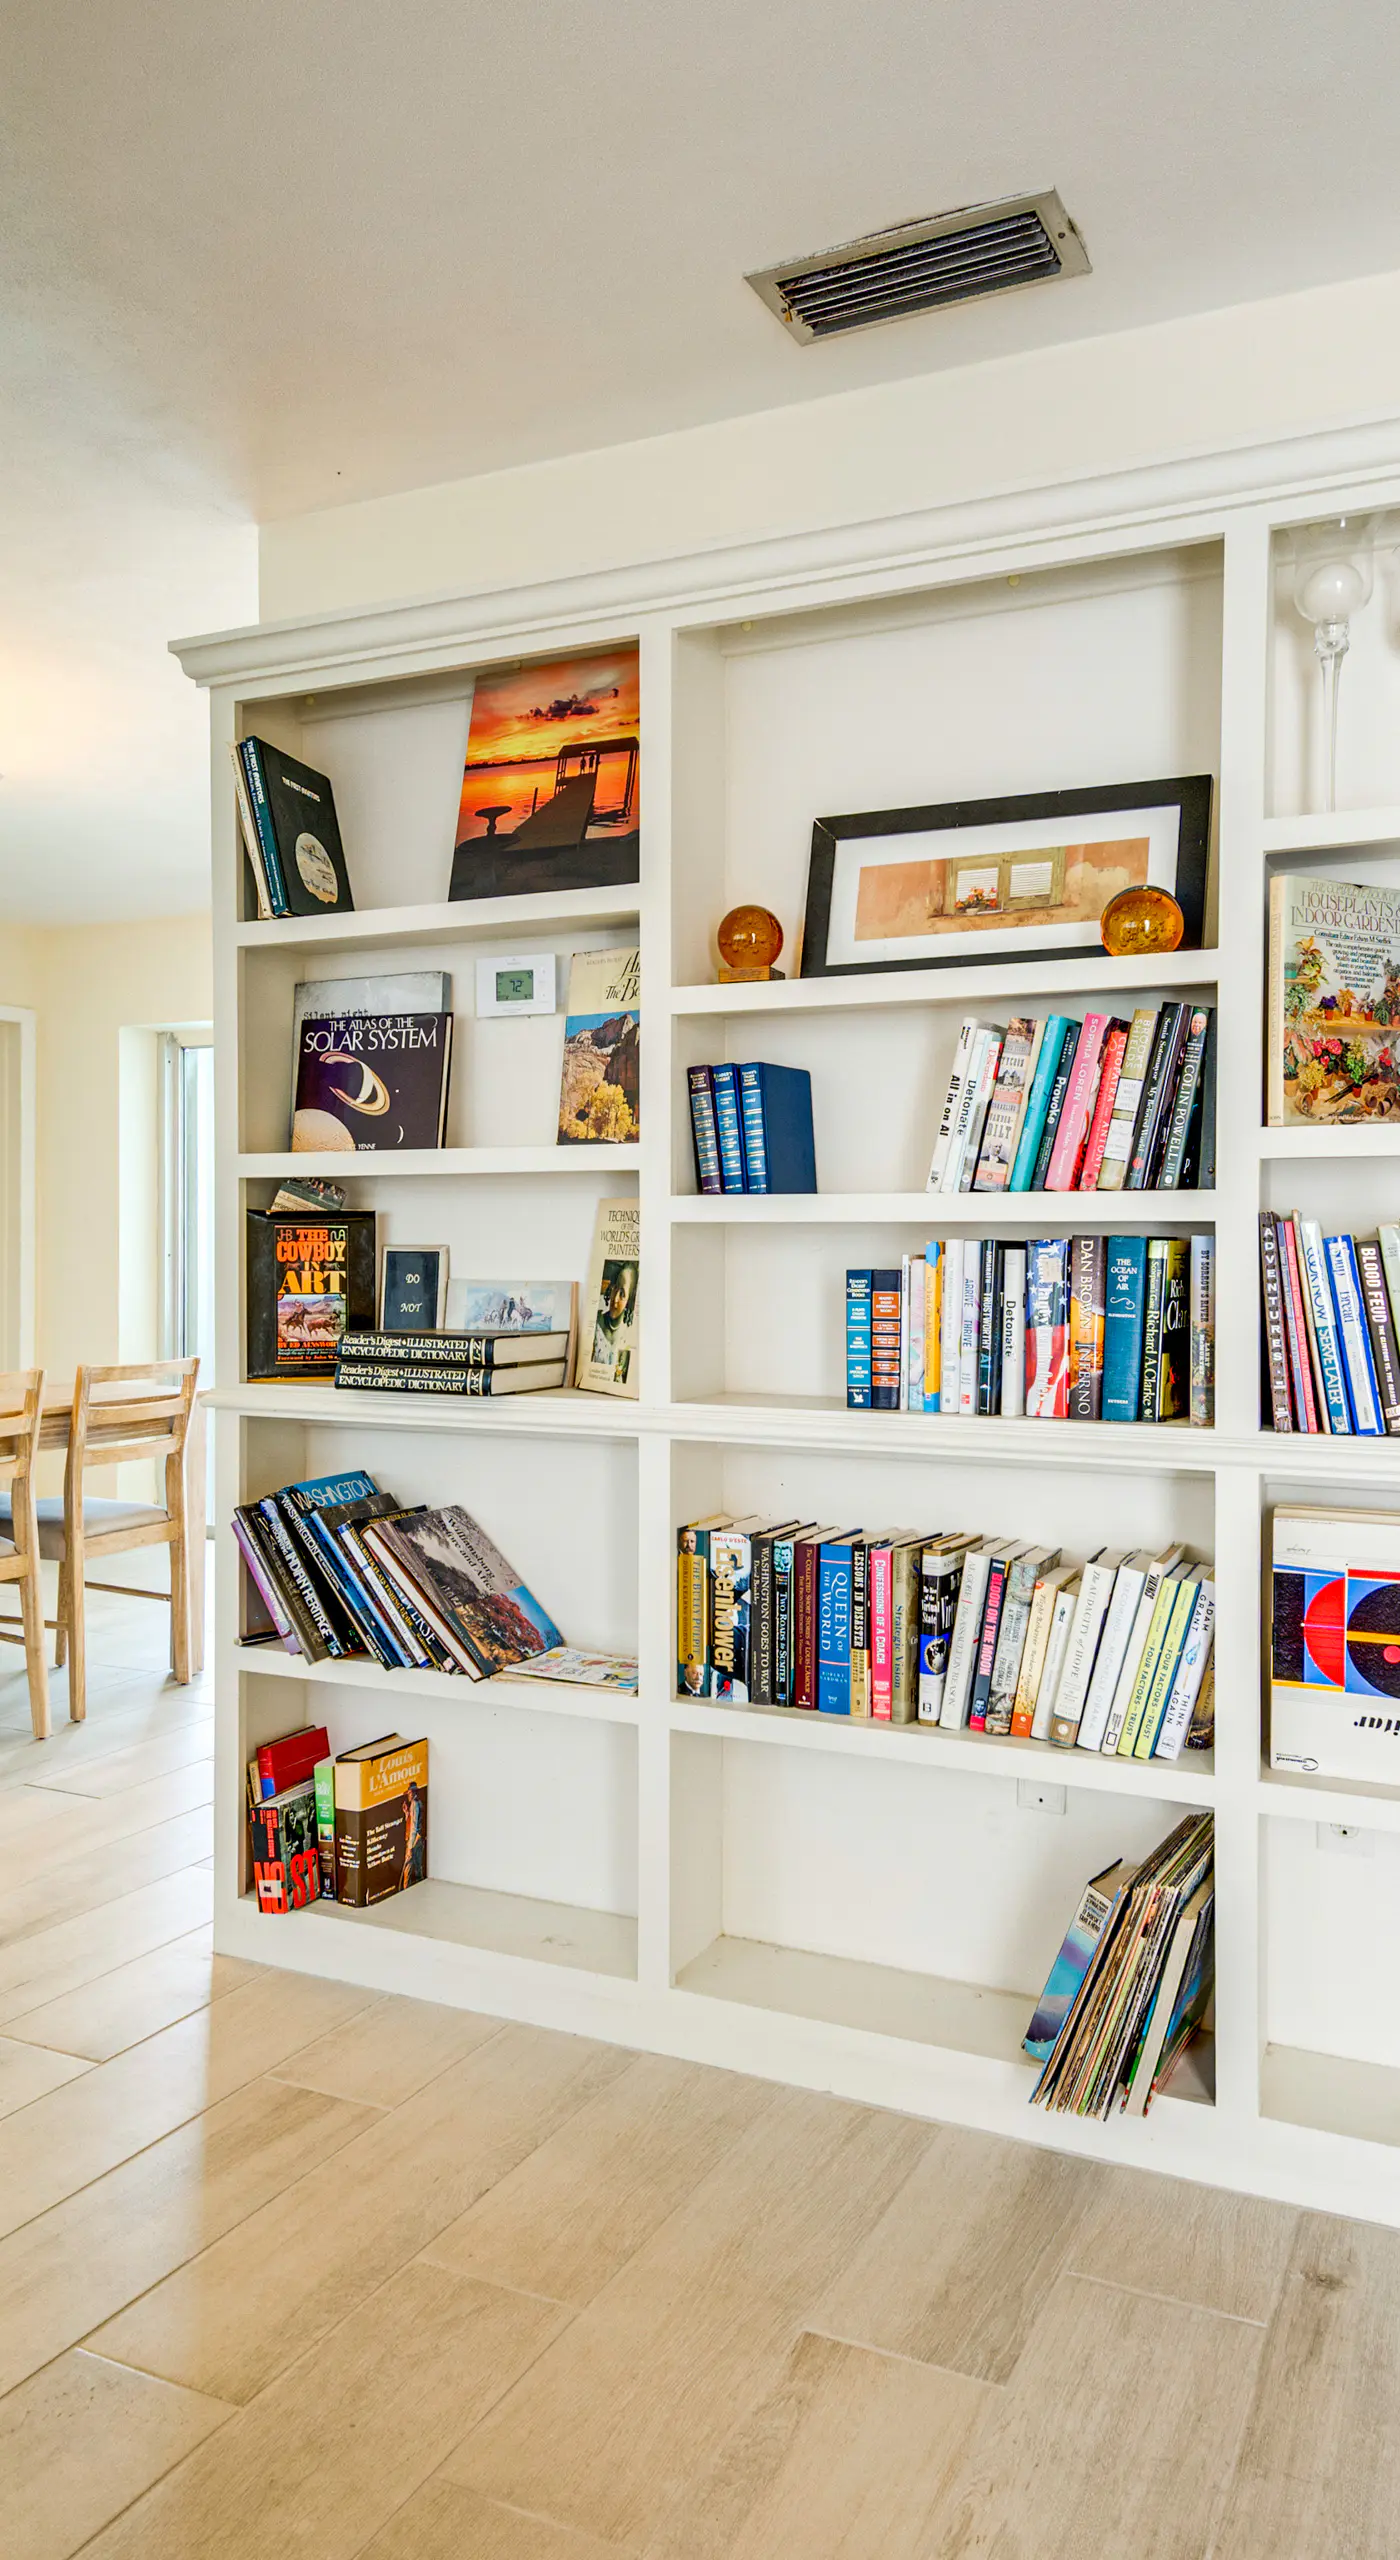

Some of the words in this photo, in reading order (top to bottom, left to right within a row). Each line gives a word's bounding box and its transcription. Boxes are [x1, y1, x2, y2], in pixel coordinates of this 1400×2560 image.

[1302, 891, 1393, 918] HOUSEPLANTS
[1292, 906, 1342, 927] INDOOR
[1344, 913, 1400, 934] GARDENI
[510, 980, 522, 992] 72
[606, 986, 618, 1000] The
[329, 1020, 346, 1031] THE
[349, 1018, 376, 1030] ATLAS
[379, 1018, 392, 1029] OF
[397, 1017, 414, 1028] THE
[1082, 1016, 1098, 1059] SOPHIA
[1160, 1016, 1171, 1039] Sonia
[304, 1031, 363, 1052] SOLAR
[368, 1028, 436, 1050] SYSTEM
[1126, 1019, 1143, 1069] SHIELDS
[1134, 1019, 1153, 1069] BROOKE
[1106, 1035, 1126, 1103] CLEOPATRA
[1150, 1040, 1166, 1080] Sotomayor
[949, 1074, 961, 1090] All
[1073, 1062, 1088, 1100] LOREN
[1147, 1084, 1157, 1096] My
[1178, 1063, 1195, 1105] COLIN
[946, 1092, 957, 1104] in
[957, 1080, 976, 1136] Detonate
[1047, 1076, 1066, 1124] Provoke
[942, 1106, 952, 1121] on
[1093, 1120, 1109, 1168] ANTONY
[1167, 1105, 1187, 1160] POWELL
[296, 1230, 328, 1241] THE
[600, 1231, 629, 1242] WORLD'S
[276, 1241, 345, 1262] COWBOY
[304, 1262, 320, 1271] IN
[1080, 1240, 1094, 1272] DAN
[1201, 1250, 1209, 1260] BY
[1360, 1245, 1381, 1287] BLOOD
[278, 1270, 346, 1294] ART
[406, 1274, 420, 1284] DO
[1111, 1266, 1137, 1274] OCEAN
[1201, 1263, 1209, 1299] SORROW'S
[400, 1303, 422, 1312] NOT
[964, 1278, 974, 1307] ARRIVE
[1080, 1276, 1093, 1329] BROWN
[1367, 1289, 1387, 1323] FEUD
[981, 1291, 992, 1350] TRUSTWORTHY
[1201, 1300, 1209, 1322] RIVER
[342, 1334, 375, 1346] Reader's
[376, 1336, 401, 1348] Digest
[407, 1338, 468, 1350] ILLUSTRATED
[963, 1320, 972, 1347] THRIVE
[1005, 1300, 1016, 1357] Detonate
[1144, 1310, 1159, 1354] Richard
[1377, 1324, 1386, 1335] THE
[341, 1346, 408, 1359] ENCYCLOPEDIC
[411, 1350, 467, 1361] DICTIONARY
[980, 1352, 991, 1369] AI
[1319, 1327, 1336, 1364] SERVE
[1379, 1335, 1390, 1362] CLINTONS
[340, 1365, 373, 1376] Reader's
[374, 1366, 398, 1378] Digest
[404, 1368, 465, 1380] ILLUSTRATED
[1144, 1355, 1157, 1367] A.
[338, 1376, 406, 1389] ENCYCLOPEDIC
[408, 1380, 464, 1392] DICTIONARY
[1075, 1340, 1095, 1414] INFERNO
[1142, 1367, 1156, 1406] Clarke
[1325, 1364, 1342, 1405] LATER
[1385, 1371, 1393, 1383] THE
[292, 1479, 374, 1510] WASHINGTON
[280, 1496, 318, 1554] WASHINGTON
[447, 1516, 496, 1578] Williamsburg
[692, 1560, 700, 1580] THE
[760, 1547, 770, 1620] WASHINGTON
[854, 1551, 864, 1588] LESSONS
[1090, 1570, 1101, 1584] The
[283, 1551, 311, 1589] INDIAN
[300, 1587, 334, 1638] HERITAGE
[692, 1583, 700, 1614] BULLY
[854, 1590, 864, 1602] IN
[874, 1559, 886, 1614] CONFESSIONS
[987, 1571, 1003, 1607] BLOOD
[714, 1548, 742, 1672] Eisenhower
[831, 1572, 848, 1638] QUEEN
[985, 1607, 998, 1623] ON
[1079, 1584, 1097, 1636] AUDACITY
[1111, 1581, 1131, 1631] BECOMING
[1191, 1594, 1207, 1632] GRANT
[1206, 1600, 1216, 1632] ADAM
[692, 1617, 700, 1655] PULPIT
[761, 1622, 769, 1649] GOES
[779, 1612, 787, 1639] ROADS
[821, 1592, 831, 1650] WORLD
[853, 1604, 864, 1647] DISASTER
[876, 1616, 885, 1627] OF
[893, 1604, 903, 1652] Strategic
[982, 1623, 996, 1644] THE
[837, 1641, 843, 1652] OF
[876, 1636, 886, 1664] COACH
[1074, 1637, 1085, 1649] of
[1143, 1645, 1154, 1668] FOUR
[761, 1652, 769, 1666] TO
[778, 1649, 787, 1683] SUMTER
[893, 1656, 903, 1688] Vision
[978, 1643, 993, 1676] MOON
[1069, 1649, 1083, 1679] HOPE
[1161, 1648, 1172, 1671] FOUR
[761, 1668, 769, 1692] WAR
[1133, 1669, 1148, 1706] FACTORS
[1151, 1672, 1166, 1708] FACTORS
[1166, 1690, 1179, 1725] AGAIN
[1176, 1694, 1190, 1726] THINK
[1125, 1712, 1136, 1736] TRUST
[1142, 1715, 1153, 1739] TRUST
[379, 1750, 413, 1773] Louis
[370, 1762, 423, 1792] L'Amour
